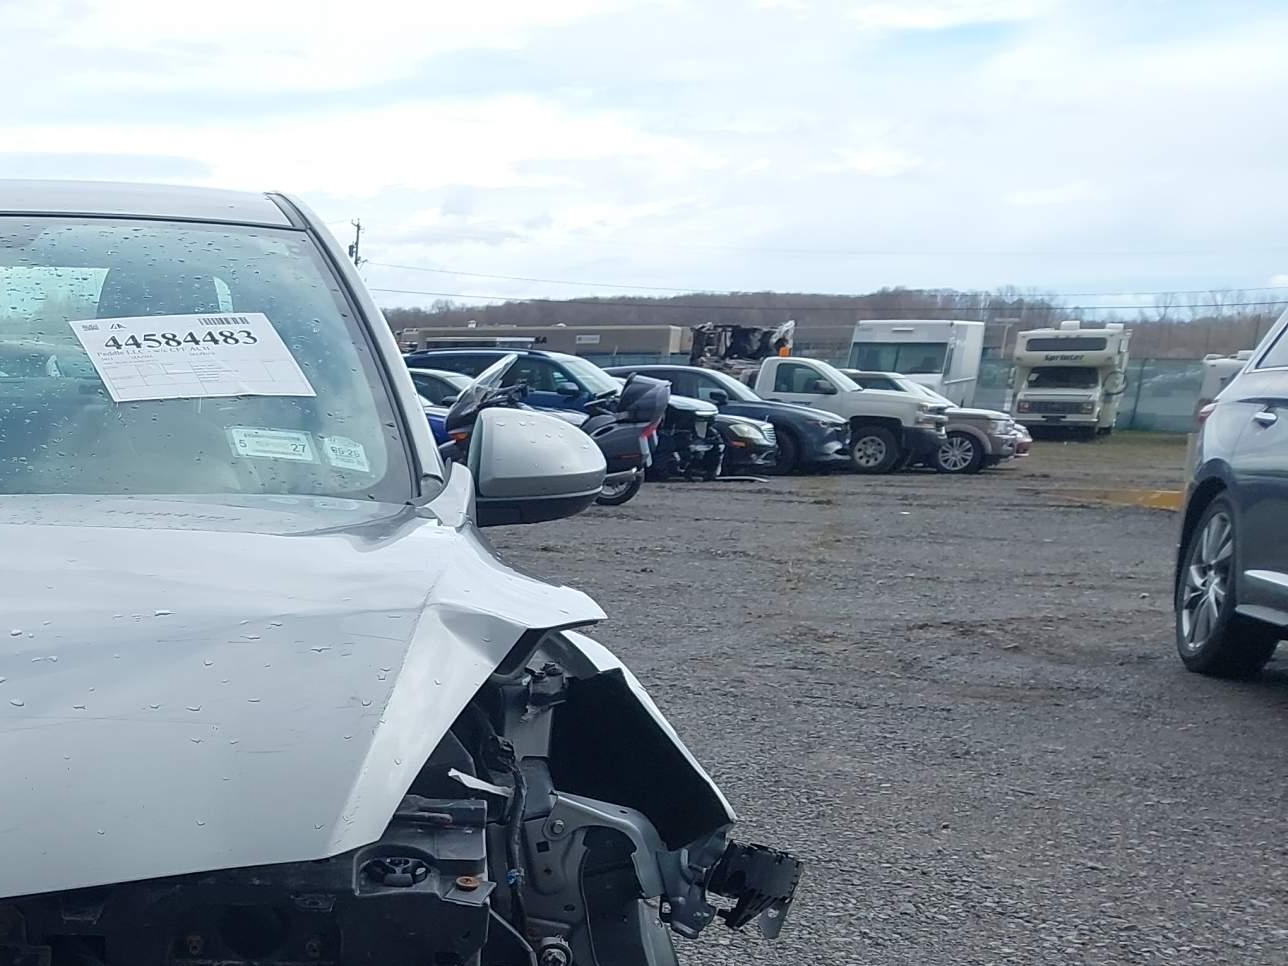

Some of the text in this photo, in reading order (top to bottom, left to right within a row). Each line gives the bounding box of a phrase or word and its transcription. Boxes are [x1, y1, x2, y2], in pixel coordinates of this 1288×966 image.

[104, 330, 258, 350] 44584483
[1044, 354, 1085, 362] Sprinter
[238, 439, 306, 453] 5 27
